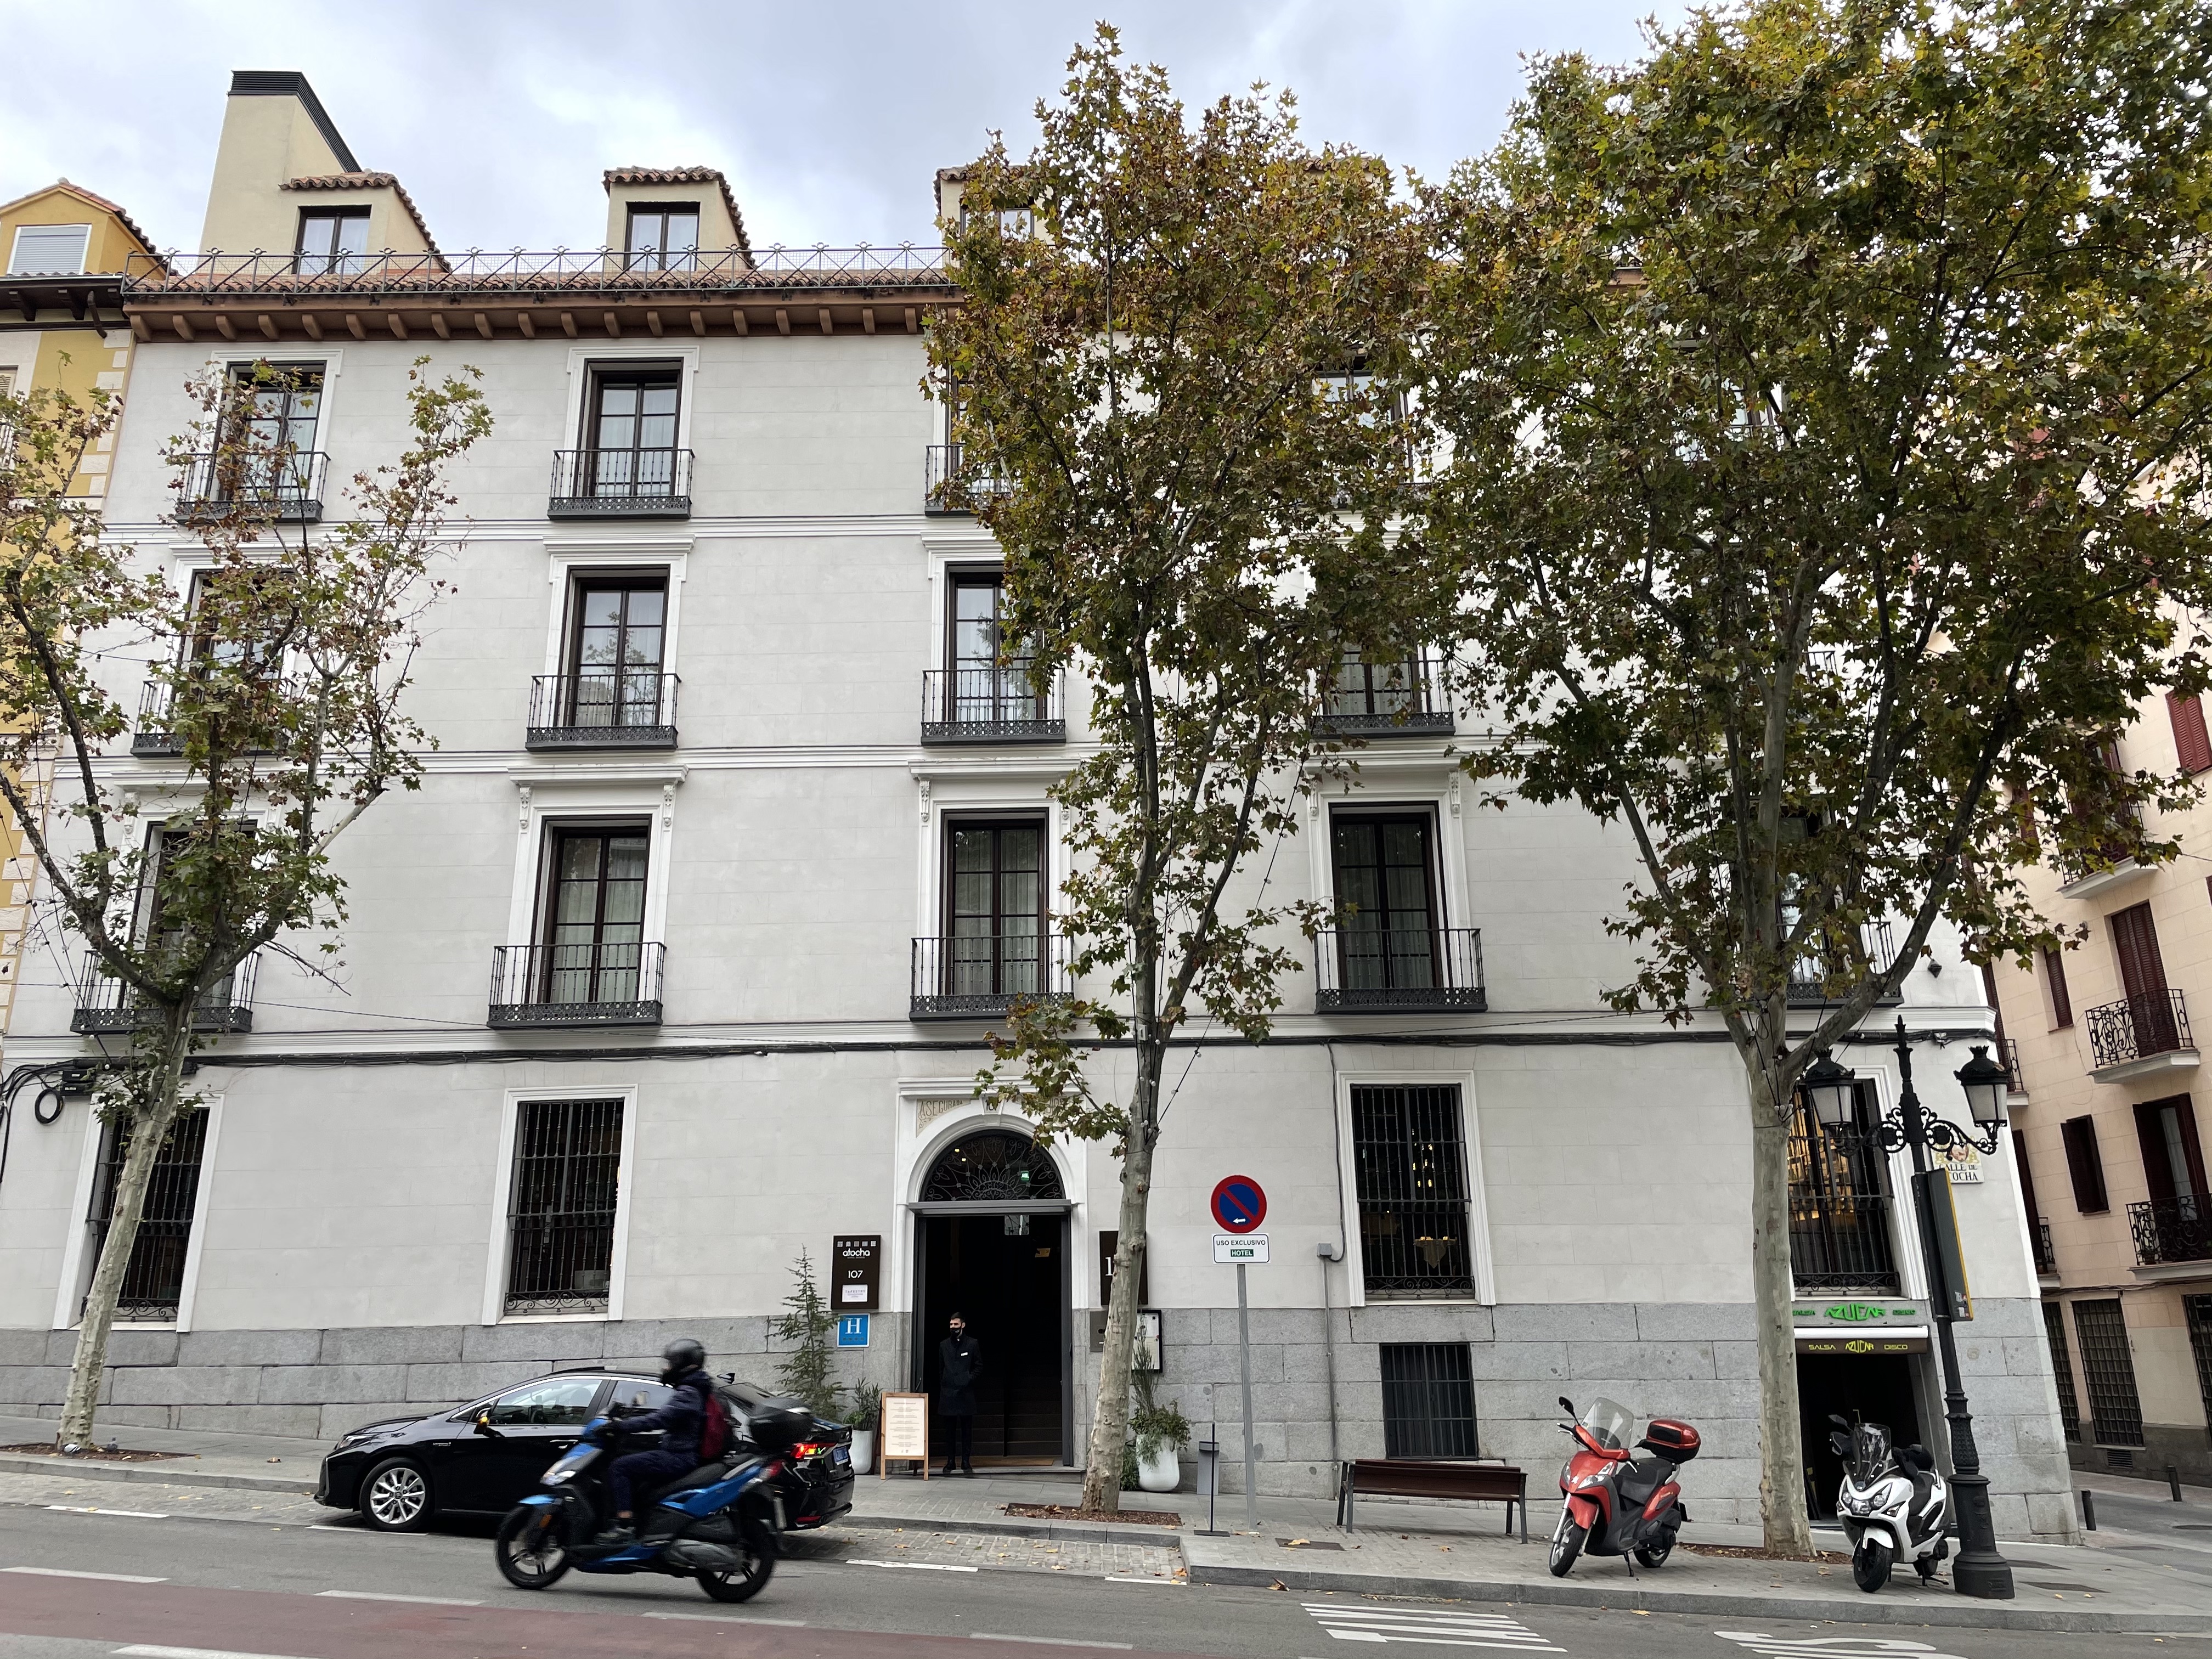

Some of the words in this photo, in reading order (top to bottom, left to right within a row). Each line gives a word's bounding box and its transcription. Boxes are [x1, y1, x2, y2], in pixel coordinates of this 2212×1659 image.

[919, 1100, 963, 1116] ASEGURADA
[1949, 1172, 1978, 1181] OCHA
[842, 1248, 871, 1256] atocha
[848, 1270, 864, 1279] 107
[845, 1318, 862, 1334] H
[1845, 1340, 1874, 1353] AZUCAR
